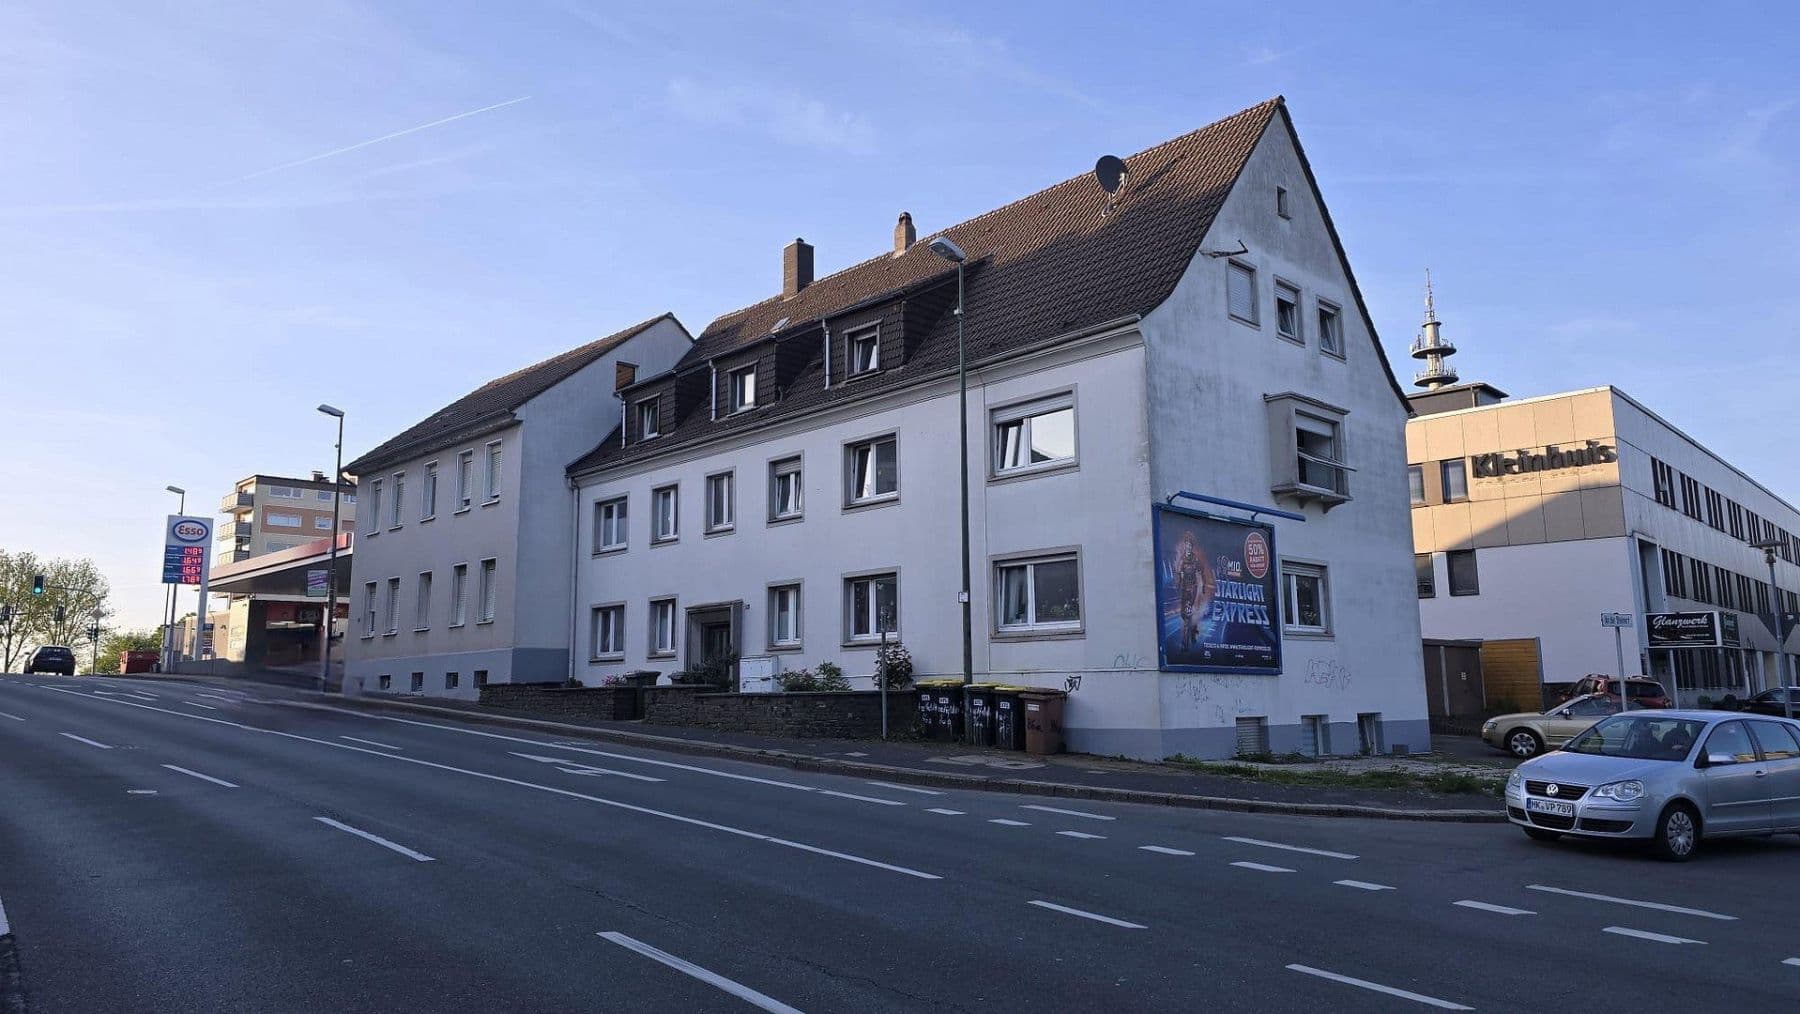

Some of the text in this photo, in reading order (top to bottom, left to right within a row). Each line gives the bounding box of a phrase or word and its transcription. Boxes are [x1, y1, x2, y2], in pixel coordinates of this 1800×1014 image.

[1472, 439, 1618, 478] Kleinhuis
[178, 525, 204, 536] Esso
[1248, 543, 1265, 555] 50%
[1214, 579, 1265, 603] STARLIGHT
[1212, 600, 1270, 626] EXPRESS
[1652, 614, 1709, 630] Glanzwerk
